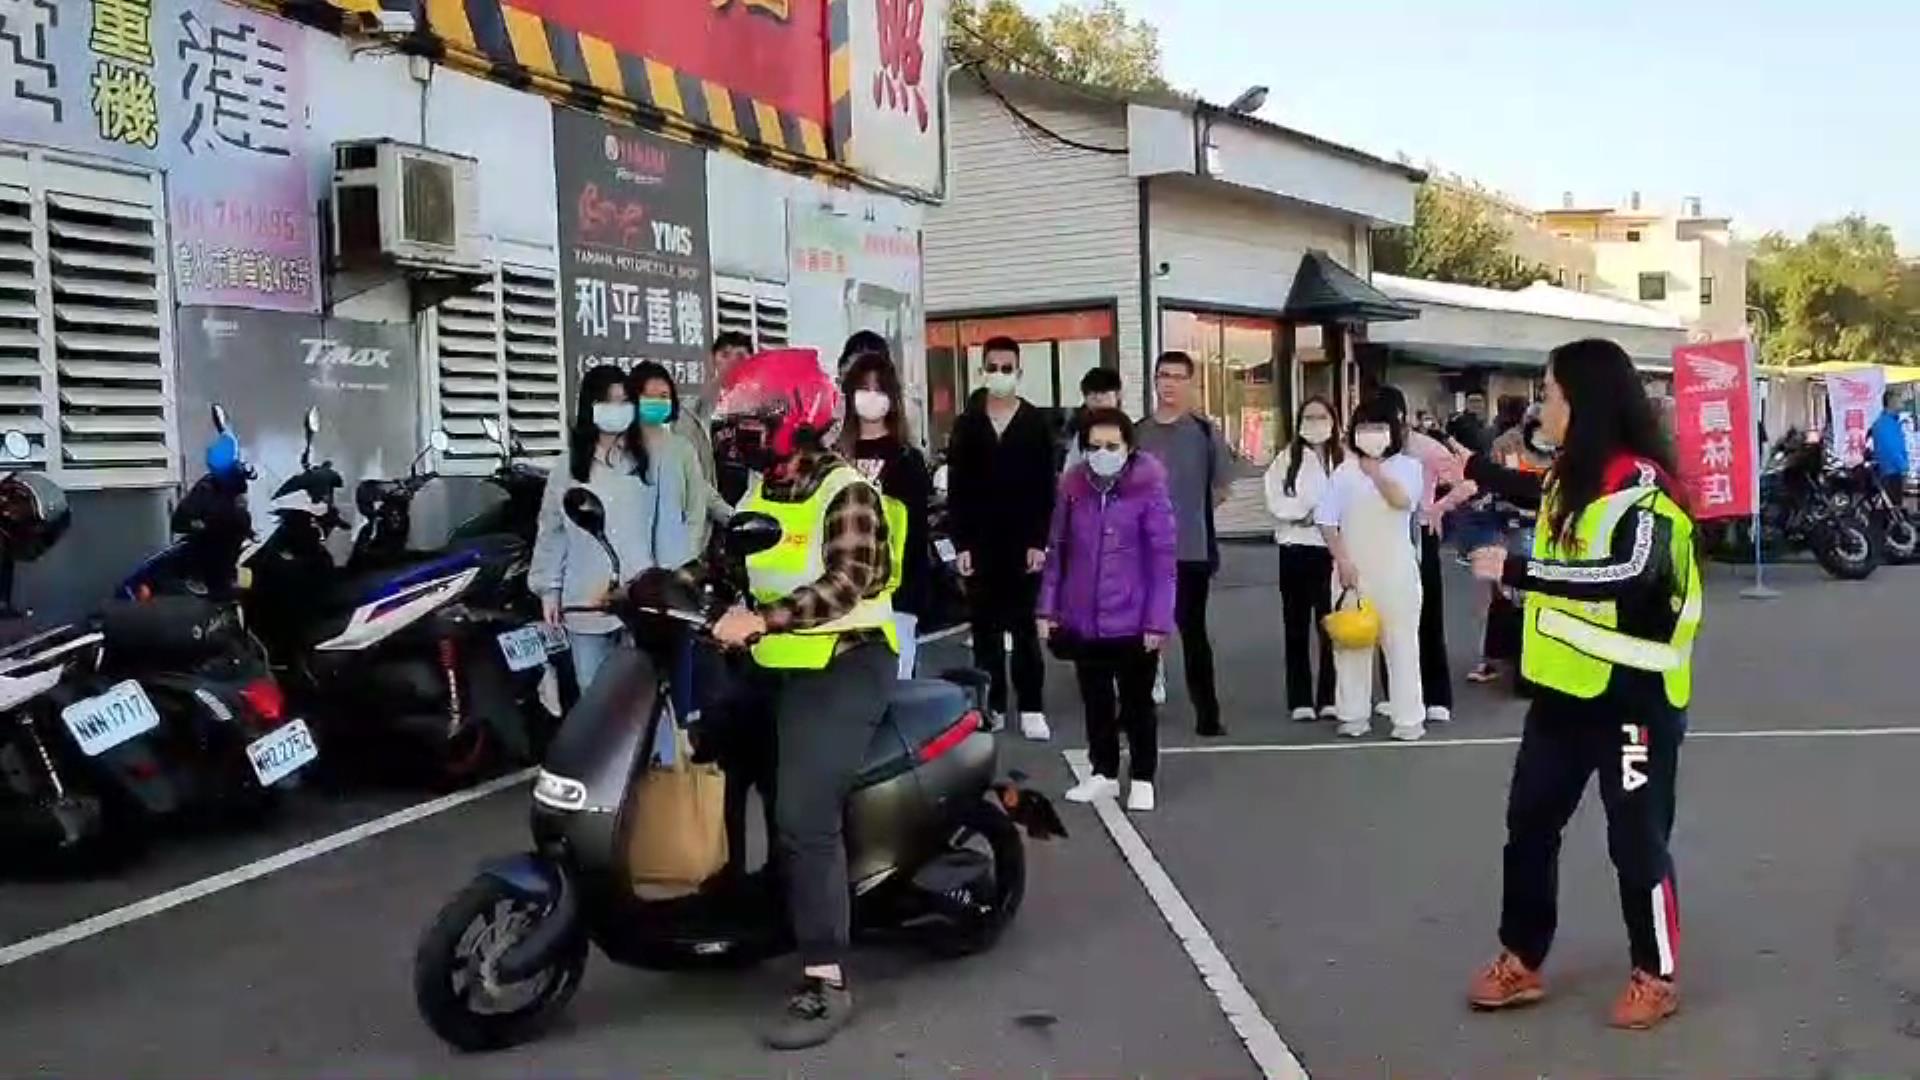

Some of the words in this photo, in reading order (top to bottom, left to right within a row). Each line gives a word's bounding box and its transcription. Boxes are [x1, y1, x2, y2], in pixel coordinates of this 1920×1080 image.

[651, 219, 693, 257] YMS
[574, 276, 705, 346] 和平重機
[1621, 723, 1649, 791] FILA
